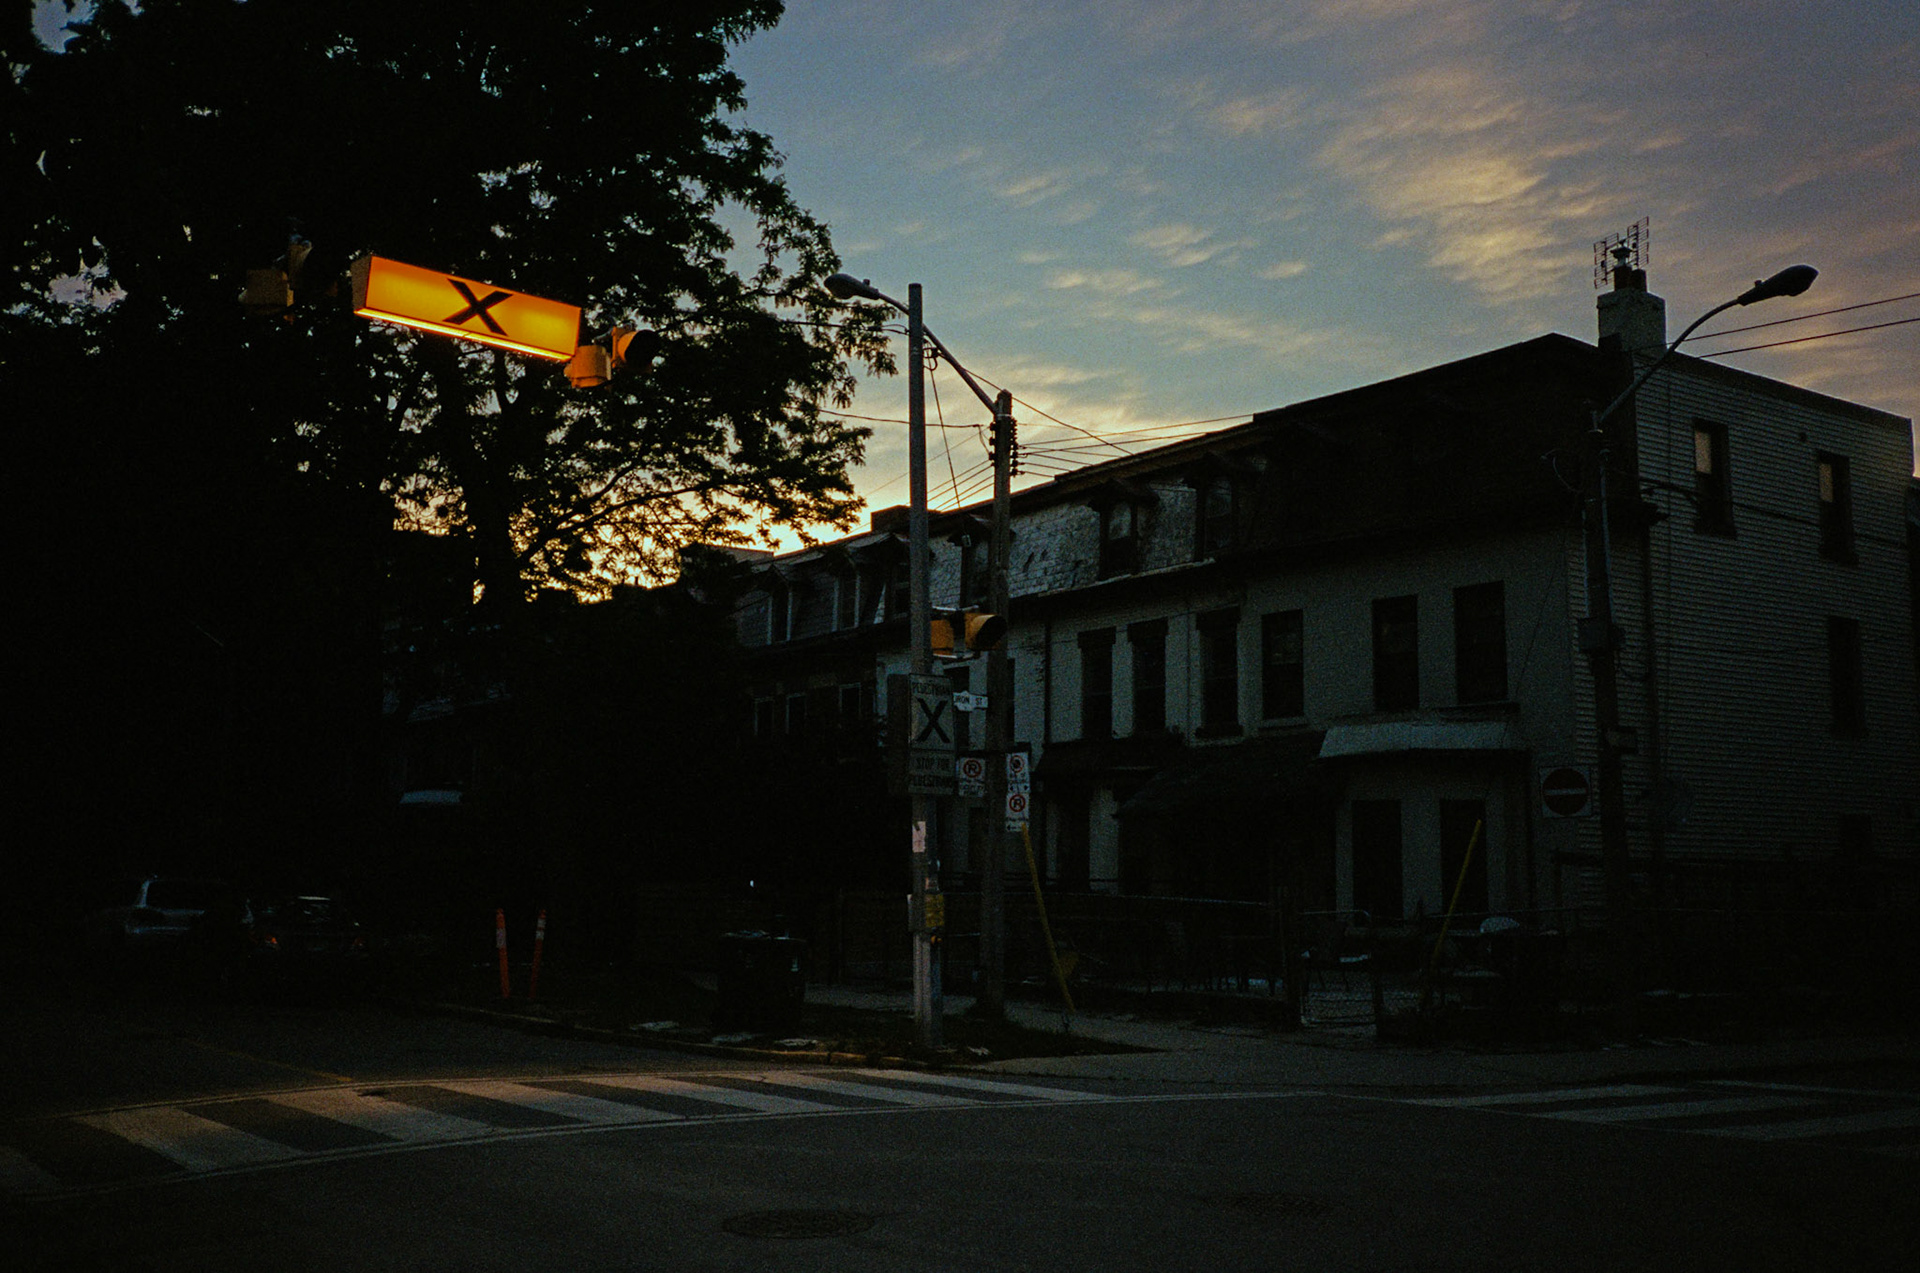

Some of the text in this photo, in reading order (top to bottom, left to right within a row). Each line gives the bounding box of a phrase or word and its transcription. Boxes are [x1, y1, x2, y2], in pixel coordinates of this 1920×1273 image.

[443, 278, 513, 336] X
[916, 698, 951, 743] X
[915, 757, 935, 770] STOP
